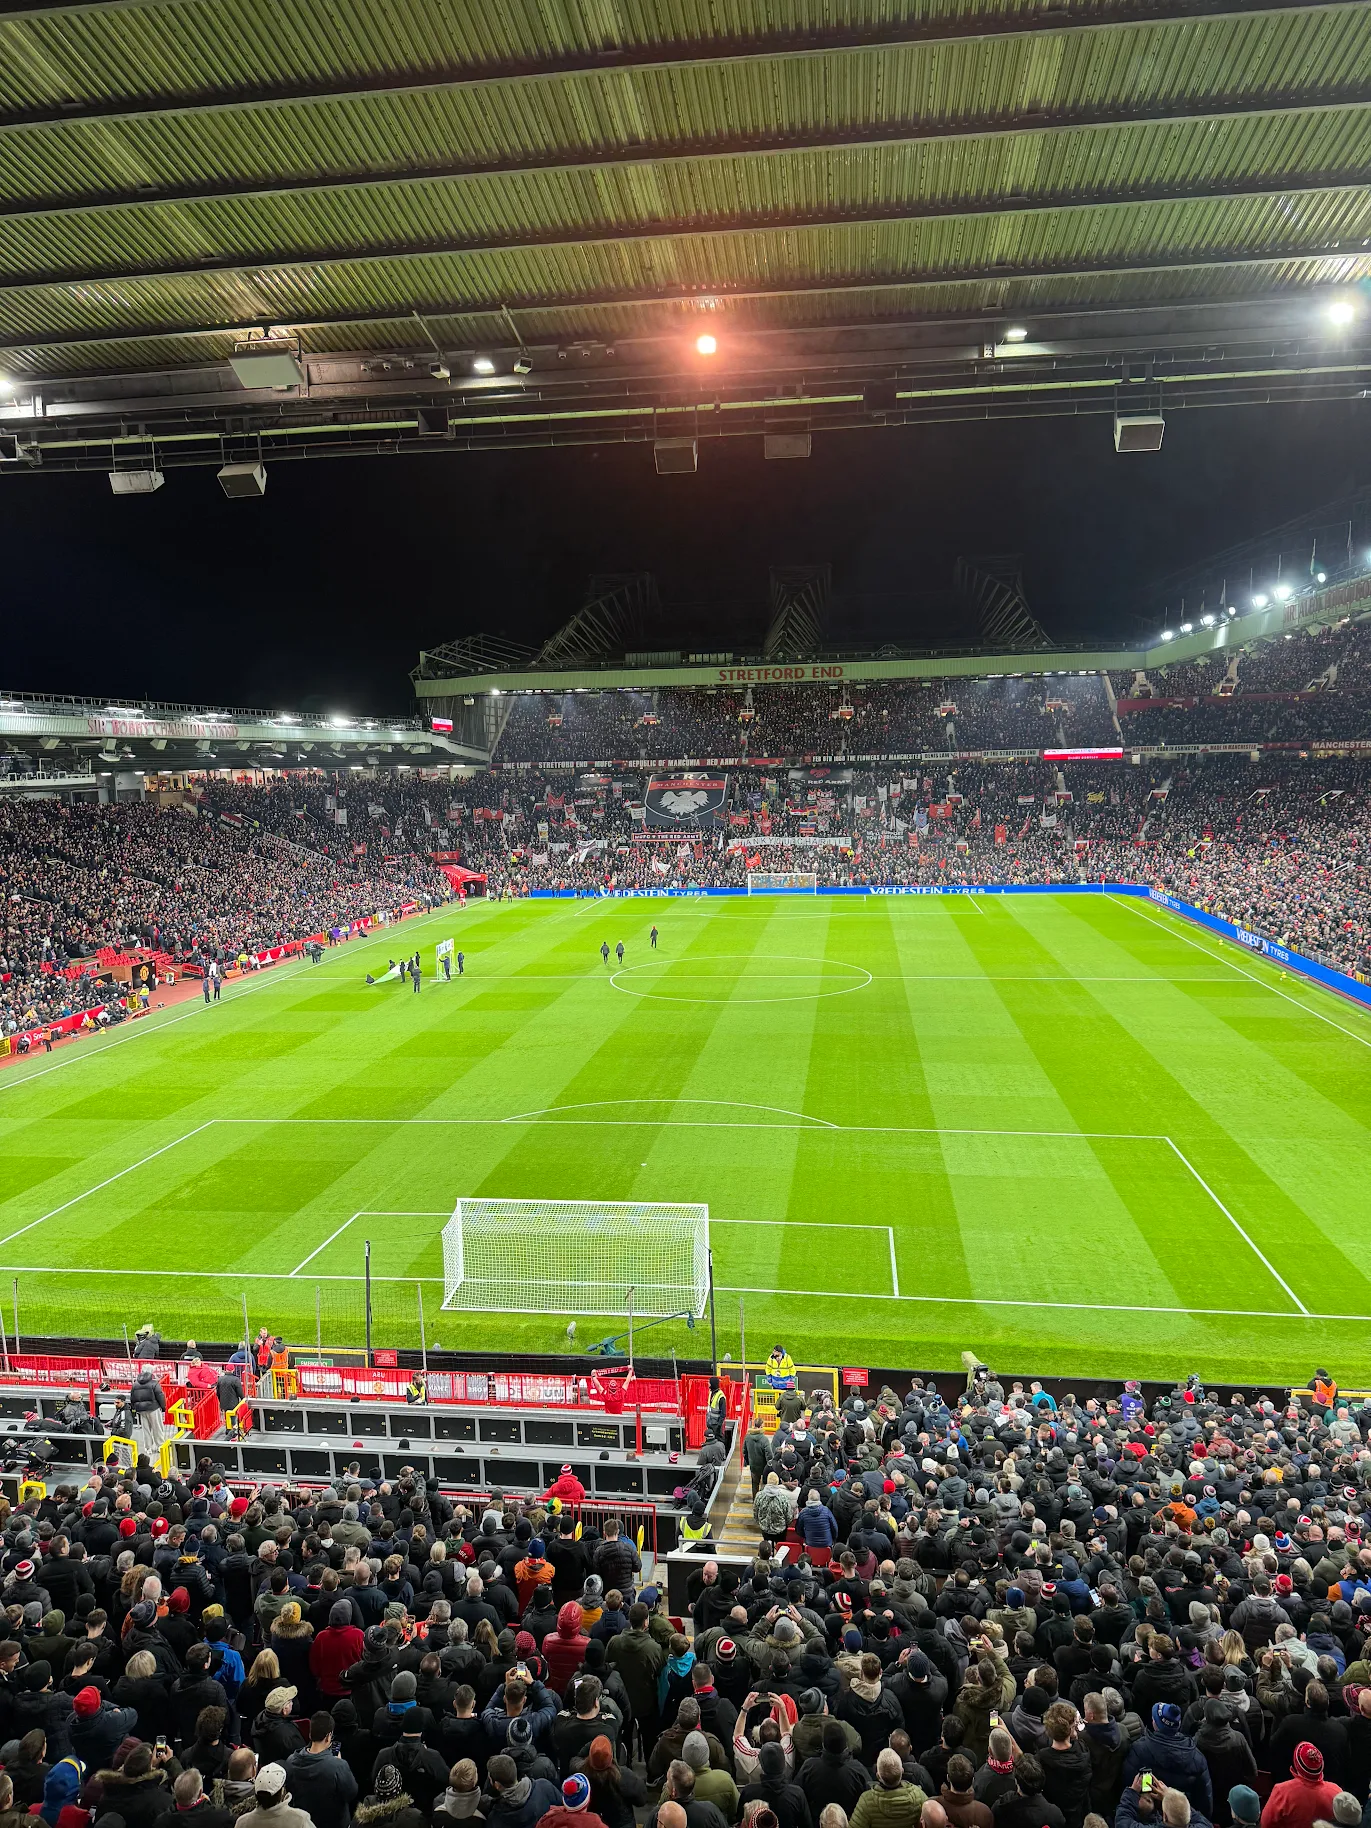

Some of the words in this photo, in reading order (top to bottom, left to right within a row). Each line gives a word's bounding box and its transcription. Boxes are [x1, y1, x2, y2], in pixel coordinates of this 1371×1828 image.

[719, 667, 805, 681] STRETFORD
[812, 666, 843, 678] END
[88, 718, 106, 733] SIR
[111, 719, 149, 736] BOBBY
[1312, 740, 1371, 749] MANCHESTER
[667, 759, 700, 767] MANCUNIA
[706, 758, 718, 766] RED
[720, 758, 739, 766] ARMY
[600, 889, 669, 897] VEDESTEIN
[869, 886, 943, 894] VREDESTEIN
[1270, 945, 1290, 961] TYRES
